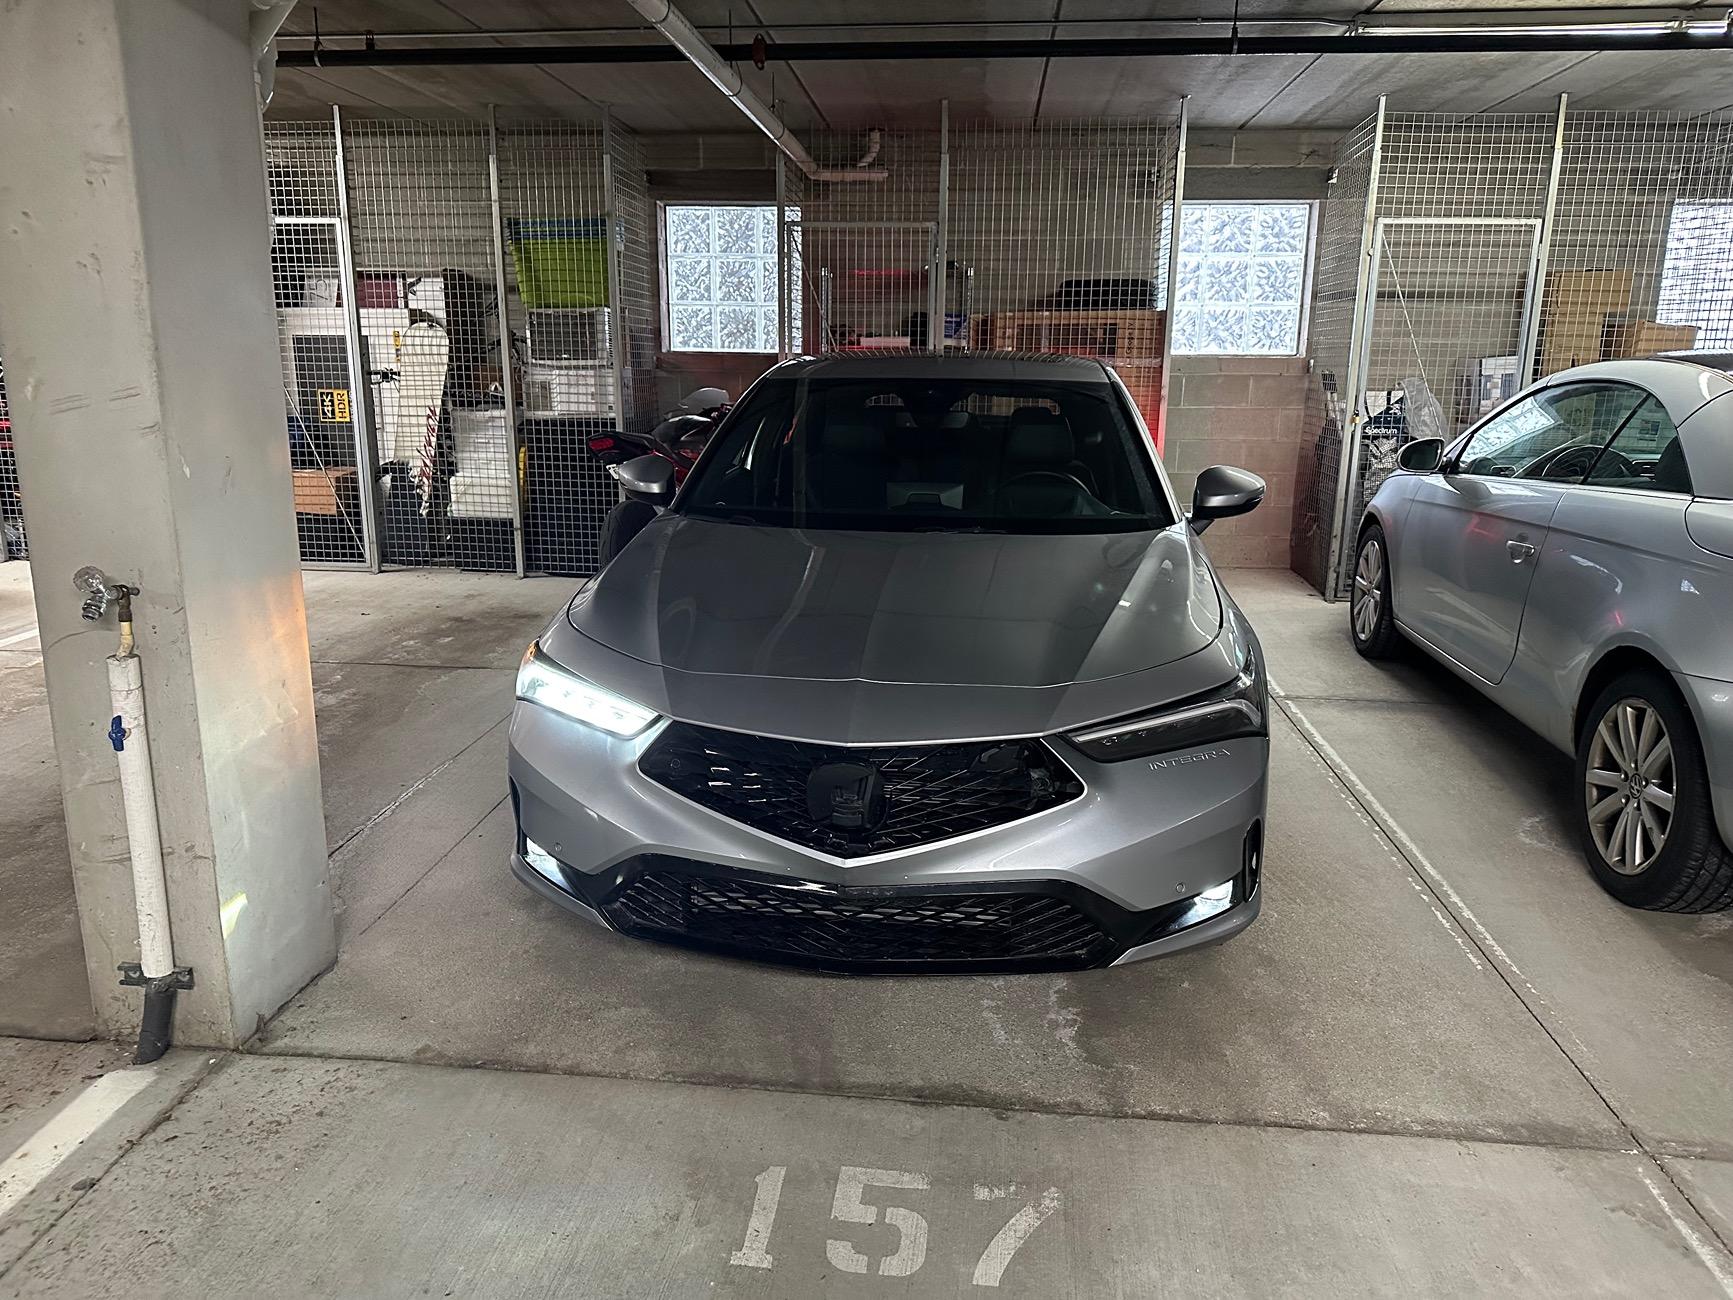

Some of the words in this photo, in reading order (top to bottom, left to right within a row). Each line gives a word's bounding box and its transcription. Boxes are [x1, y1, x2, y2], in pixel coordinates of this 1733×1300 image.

[323, 393, 332, 418] 4K
[337, 392, 347, 419] HDR
[1149, 748, 1231, 770] INTEGRA
[730, 1165, 1061, 1286] 157
